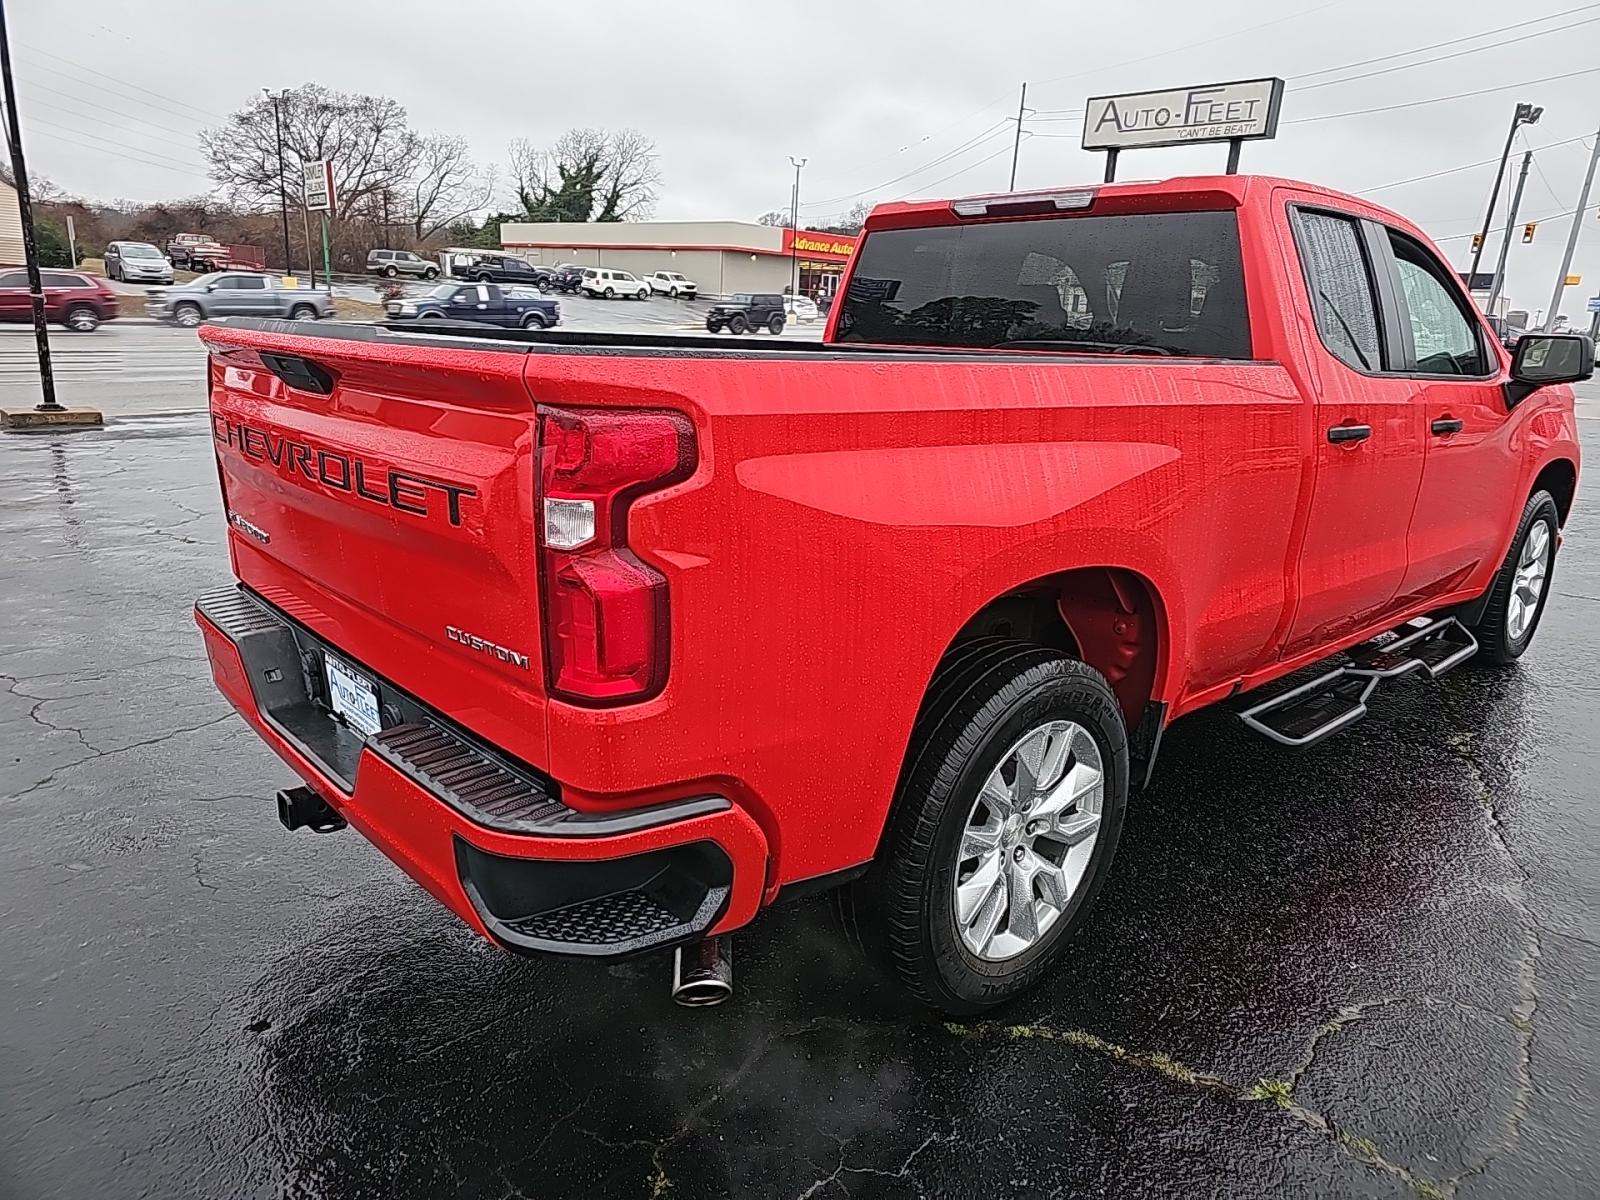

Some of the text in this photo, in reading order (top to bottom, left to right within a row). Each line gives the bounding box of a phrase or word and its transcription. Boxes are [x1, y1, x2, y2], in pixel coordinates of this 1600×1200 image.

[1208, 126, 1222, 136] BE
[789, 236, 854, 255] Advance Auto
[212, 410, 478, 527] CHEVROLET
[445, 625, 530, 671] CUSTOM
